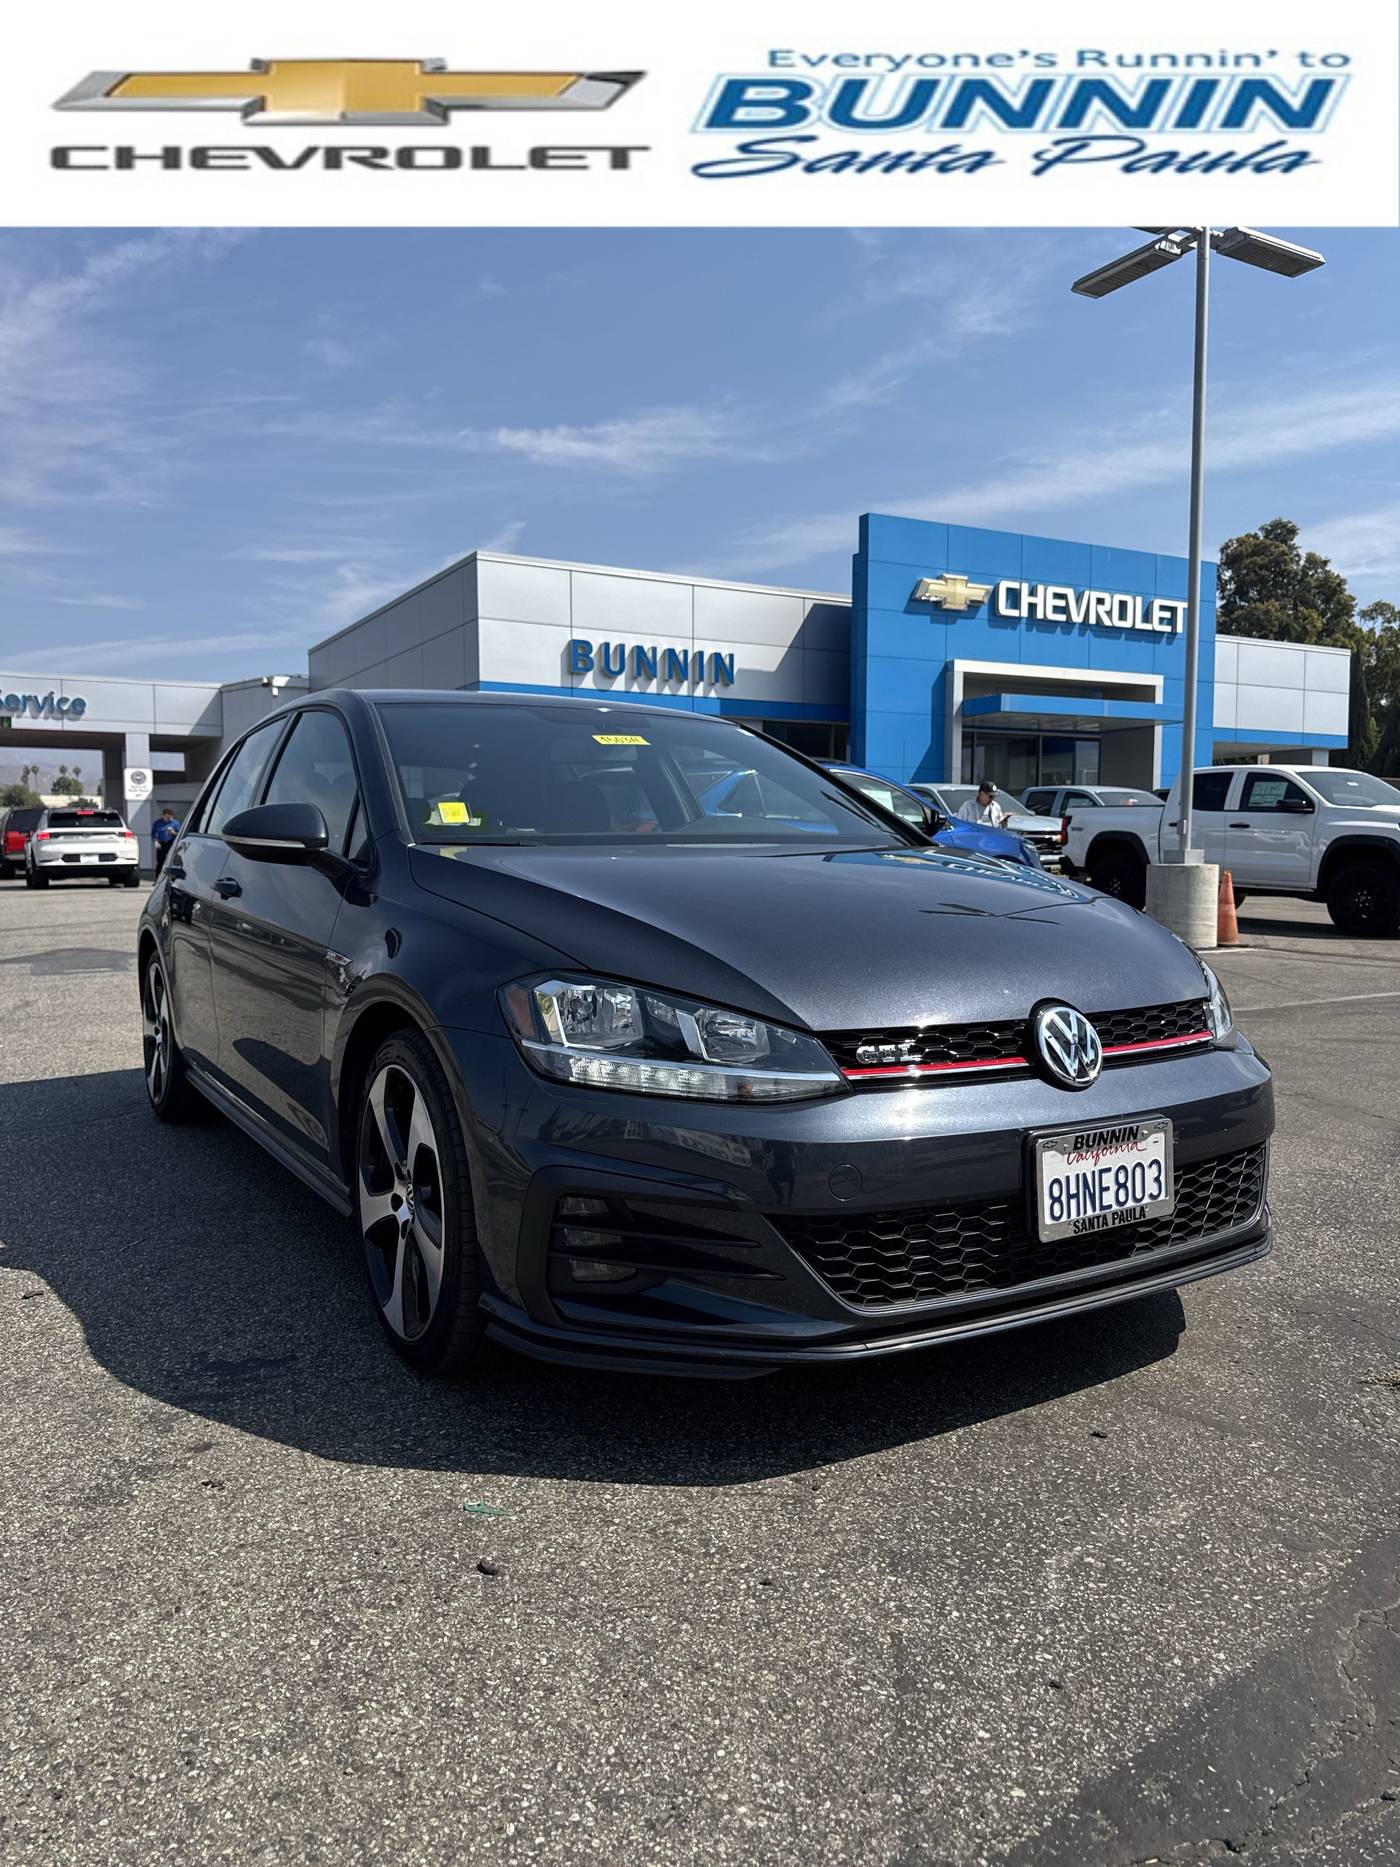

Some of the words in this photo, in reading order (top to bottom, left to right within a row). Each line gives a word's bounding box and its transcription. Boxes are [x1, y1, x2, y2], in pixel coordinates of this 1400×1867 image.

[998, 579, 1189, 634] CHEVROLET
[568, 638, 735, 686] BUNNIN
[856, 1043, 913, 1065] GTI
[1072, 1125, 1140, 1151] BUNNIN
[1066, 1141, 1148, 1167] California
[1049, 1158, 1163, 1222] 8HNE803
[1072, 1213, 1109, 1235] SANTA
[1111, 1205, 1147, 1226] PAULA
